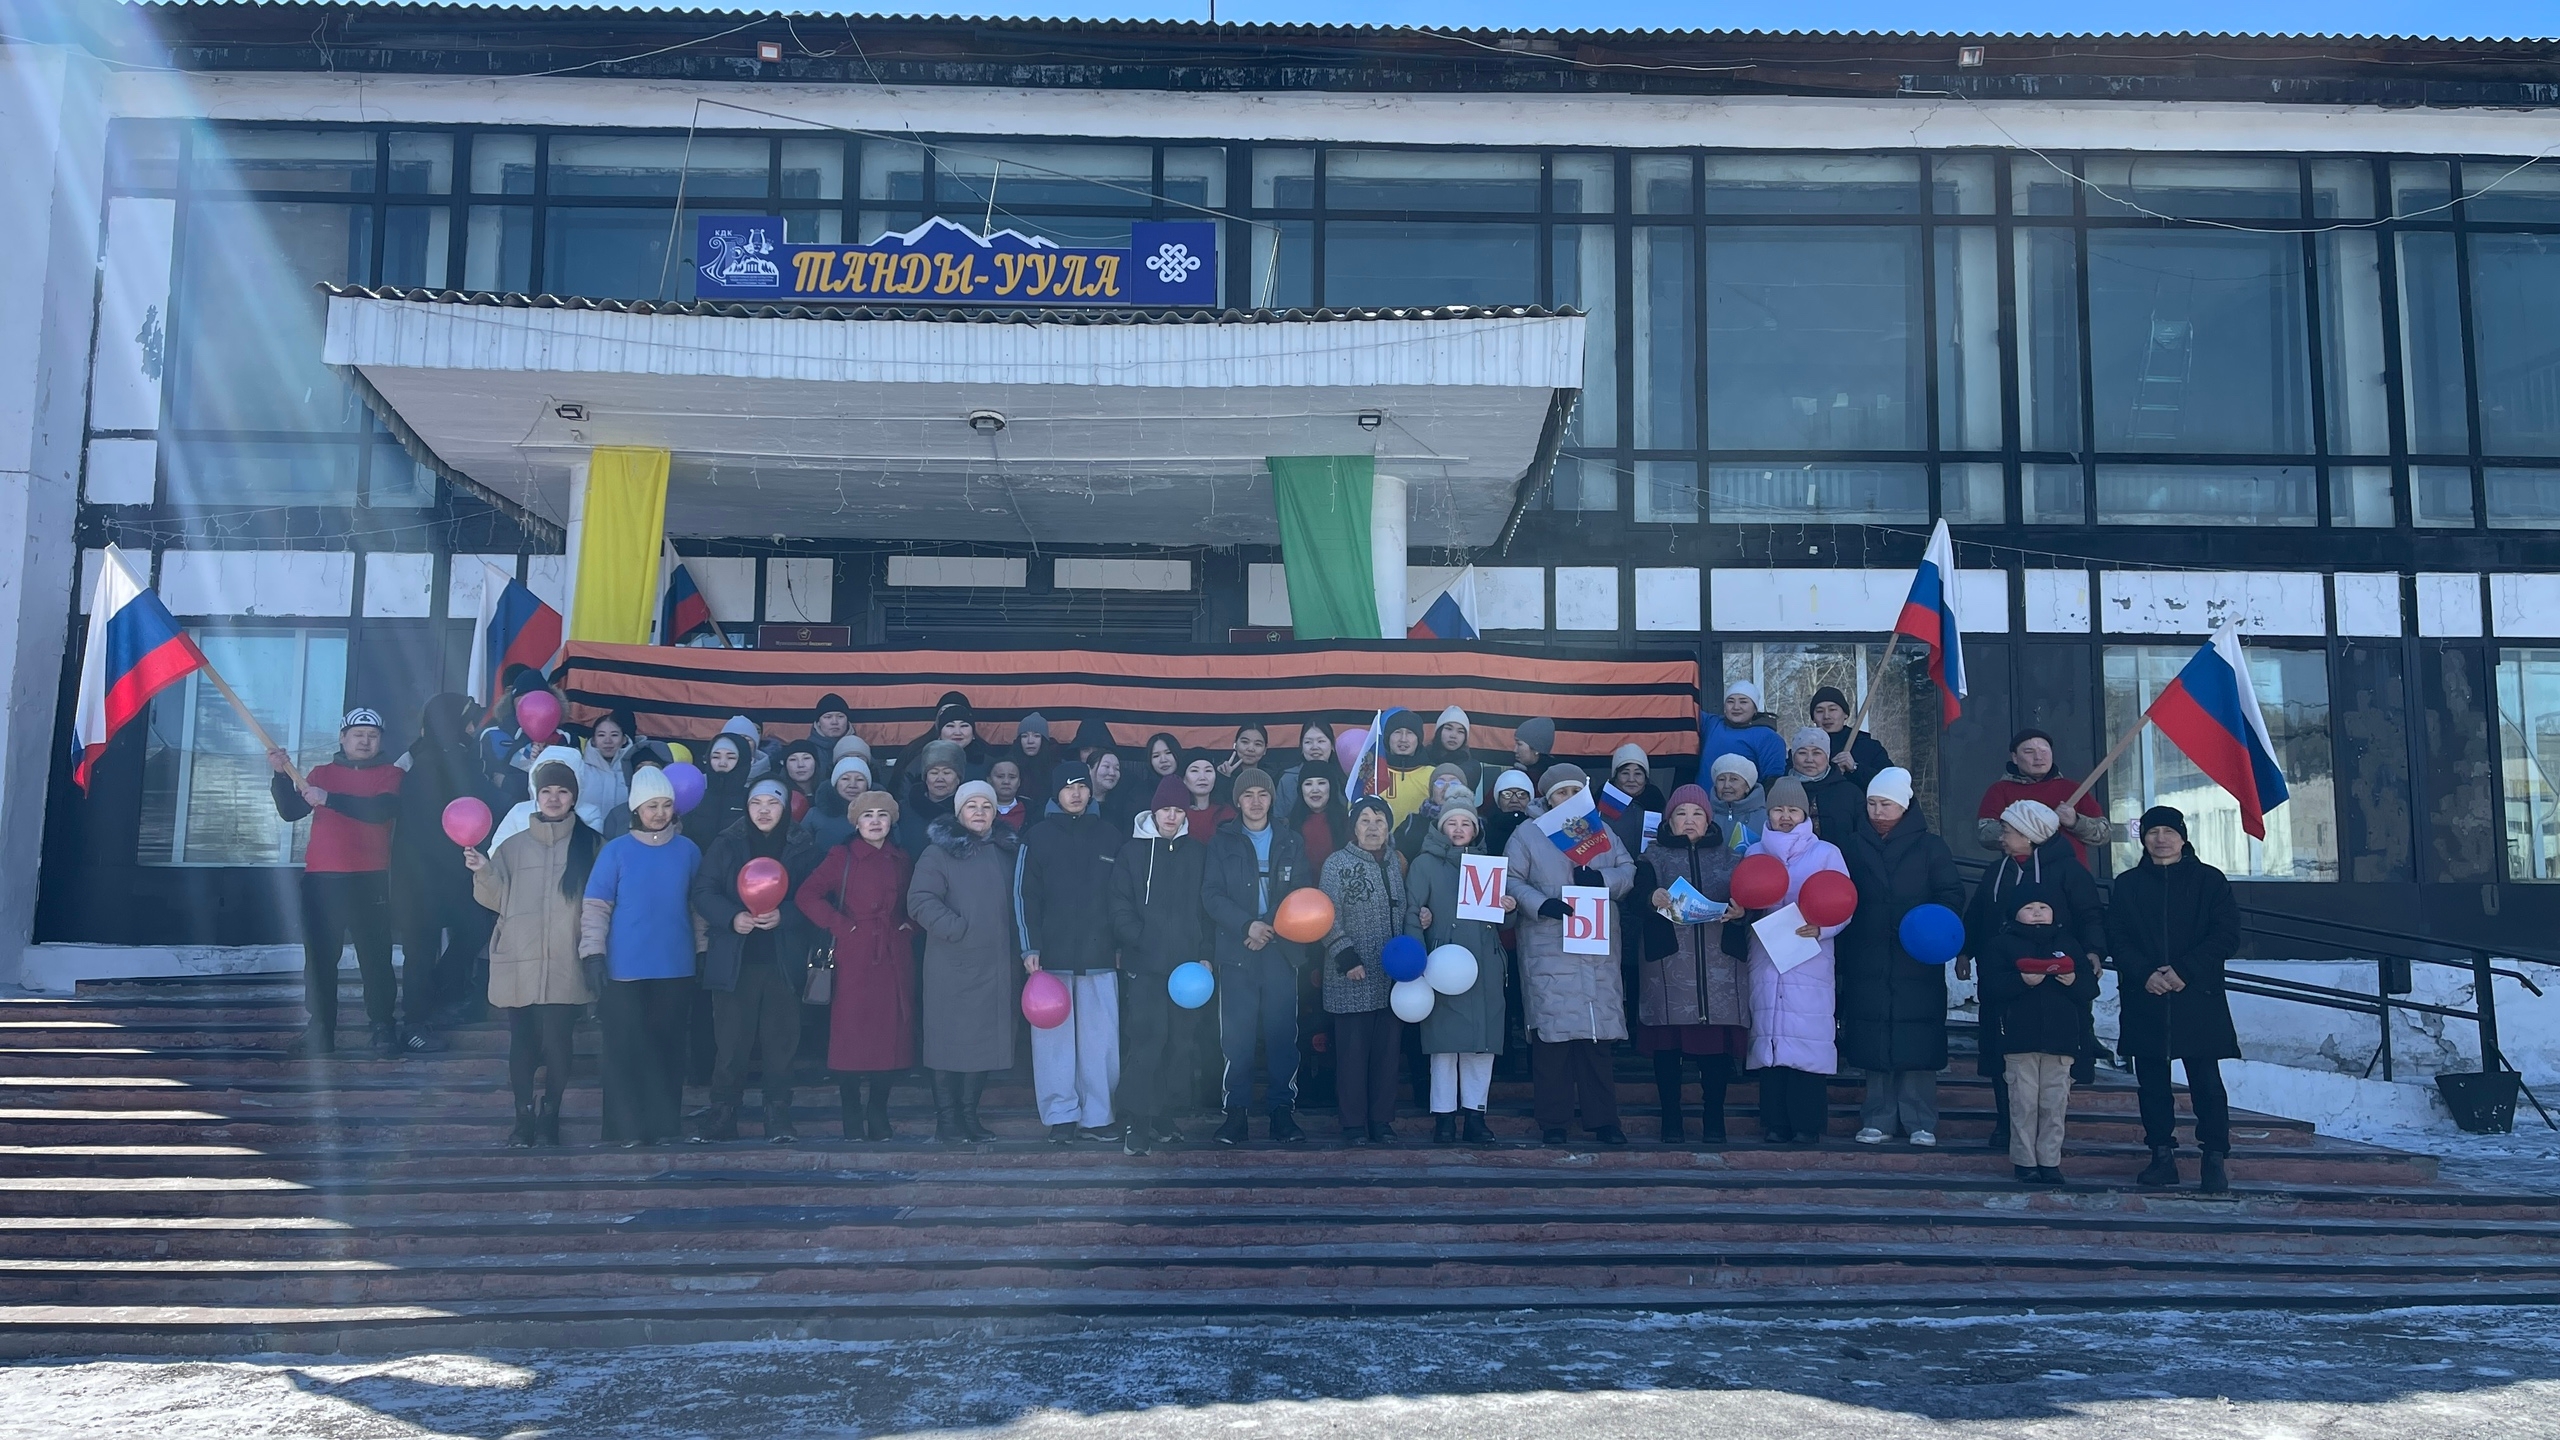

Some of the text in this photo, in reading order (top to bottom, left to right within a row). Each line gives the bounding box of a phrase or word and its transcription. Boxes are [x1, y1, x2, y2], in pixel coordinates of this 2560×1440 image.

[714, 229, 733, 238] КДК
[791, 251, 1121, 297] ТАНДЫ-УУЛА
[1459, 864, 1506, 909] М
[1564, 896, 1609, 941] Ы
